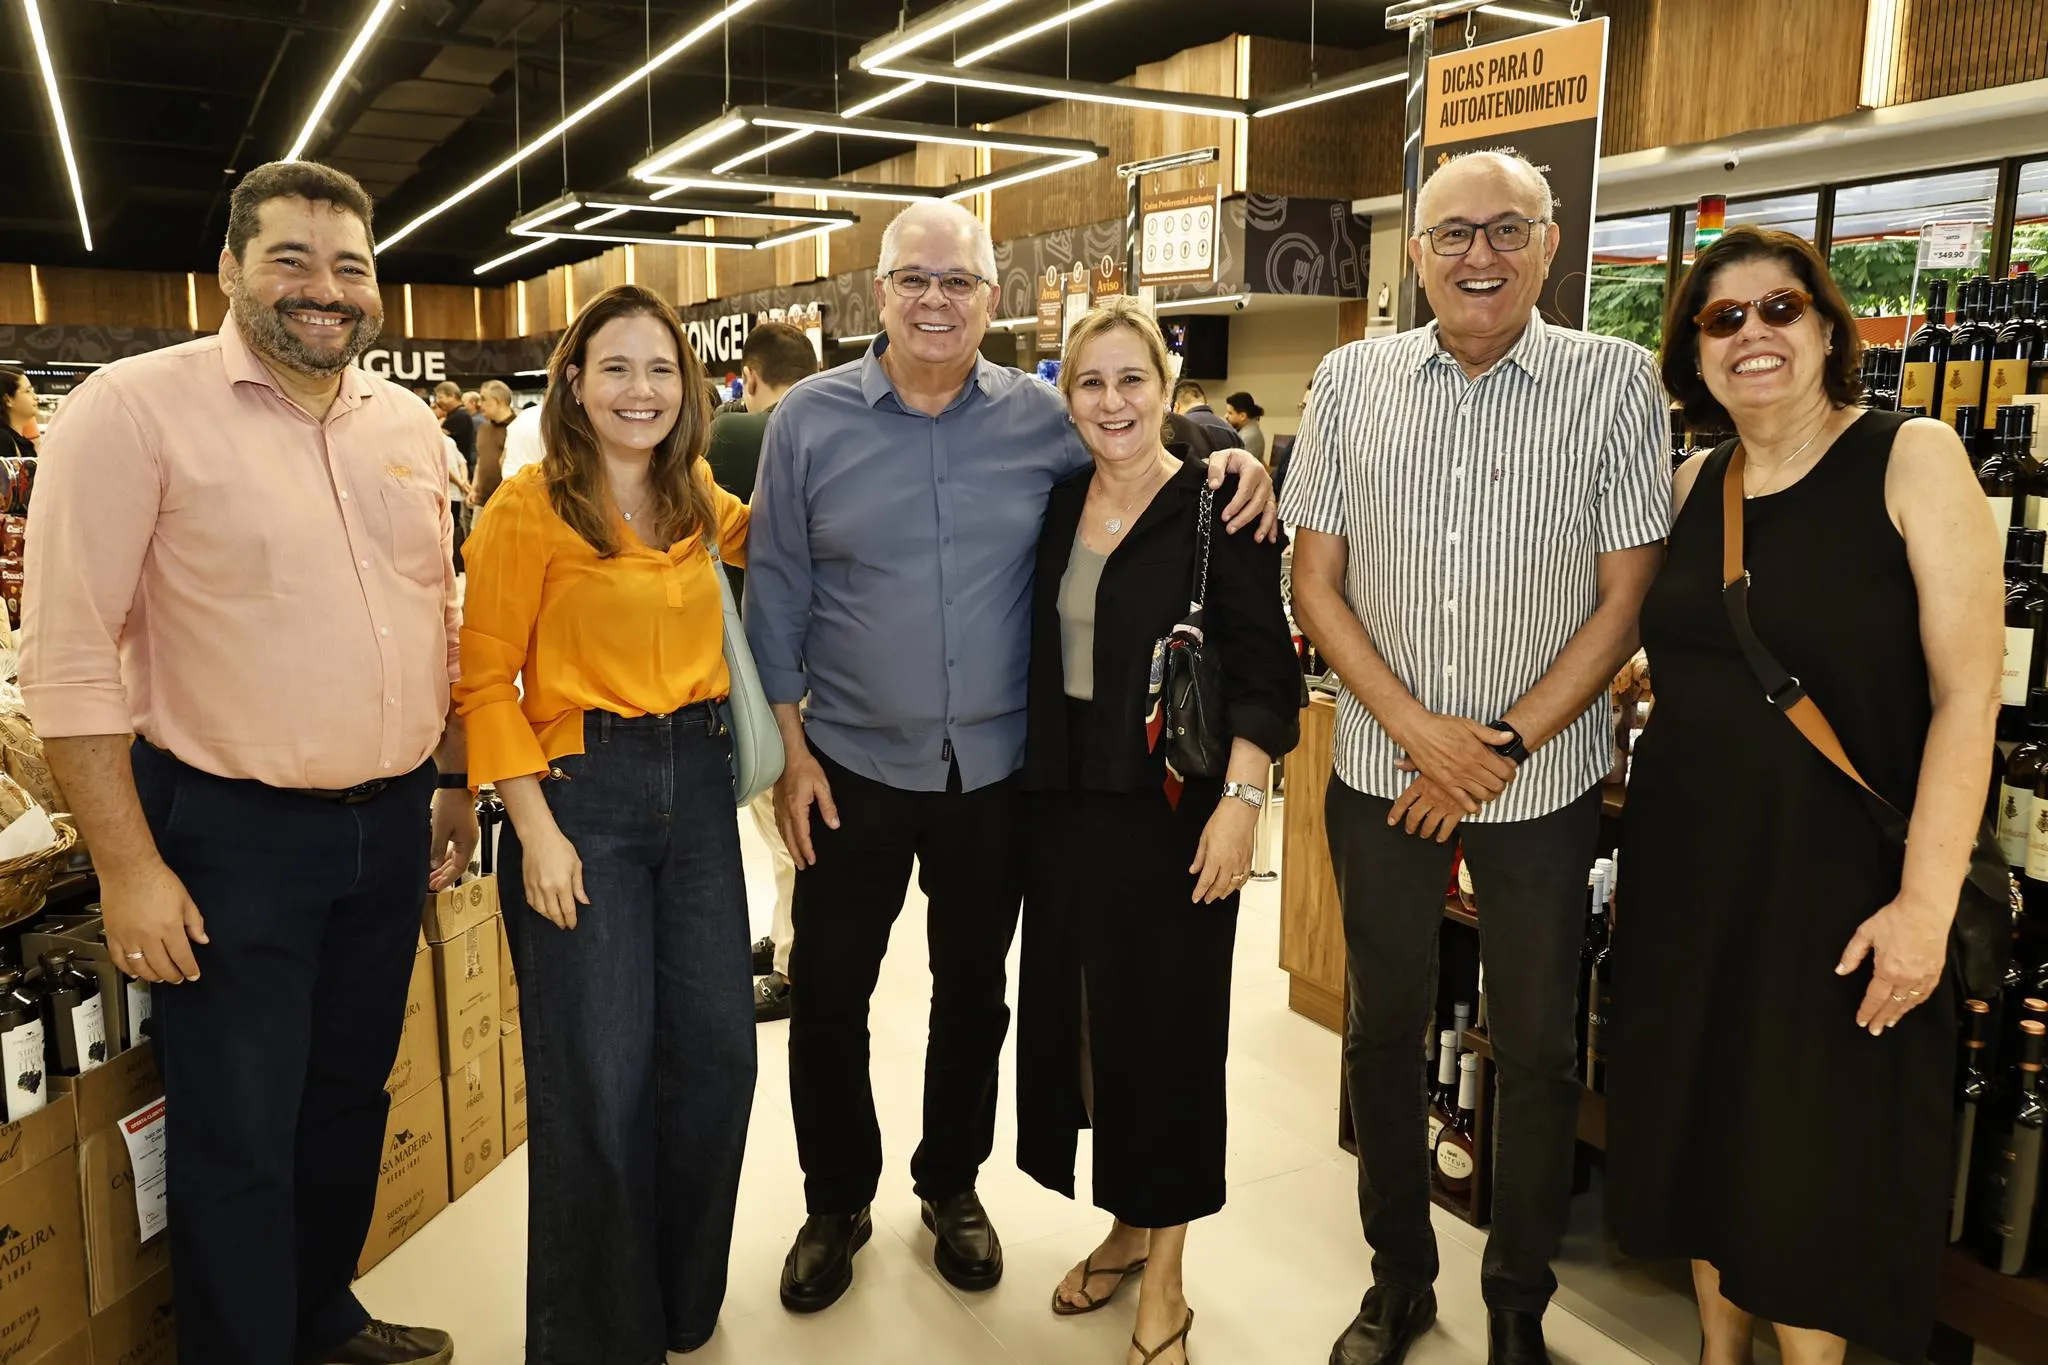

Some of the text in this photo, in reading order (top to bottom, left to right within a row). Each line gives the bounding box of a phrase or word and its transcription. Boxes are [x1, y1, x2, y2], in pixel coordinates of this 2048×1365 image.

[1442, 48, 1544, 95] DICAS PARA O
[1440, 74, 1588, 128] AUTOATENDIMENTO
[1041, 287, 1060, 300] Aviso
[1097, 279, 1119, 293] Aviso
[354, 349, 447, 381] GUE
[394, 1131, 433, 1168] MADEIRA
[0, 1224, 56, 1272] ADEIRA
